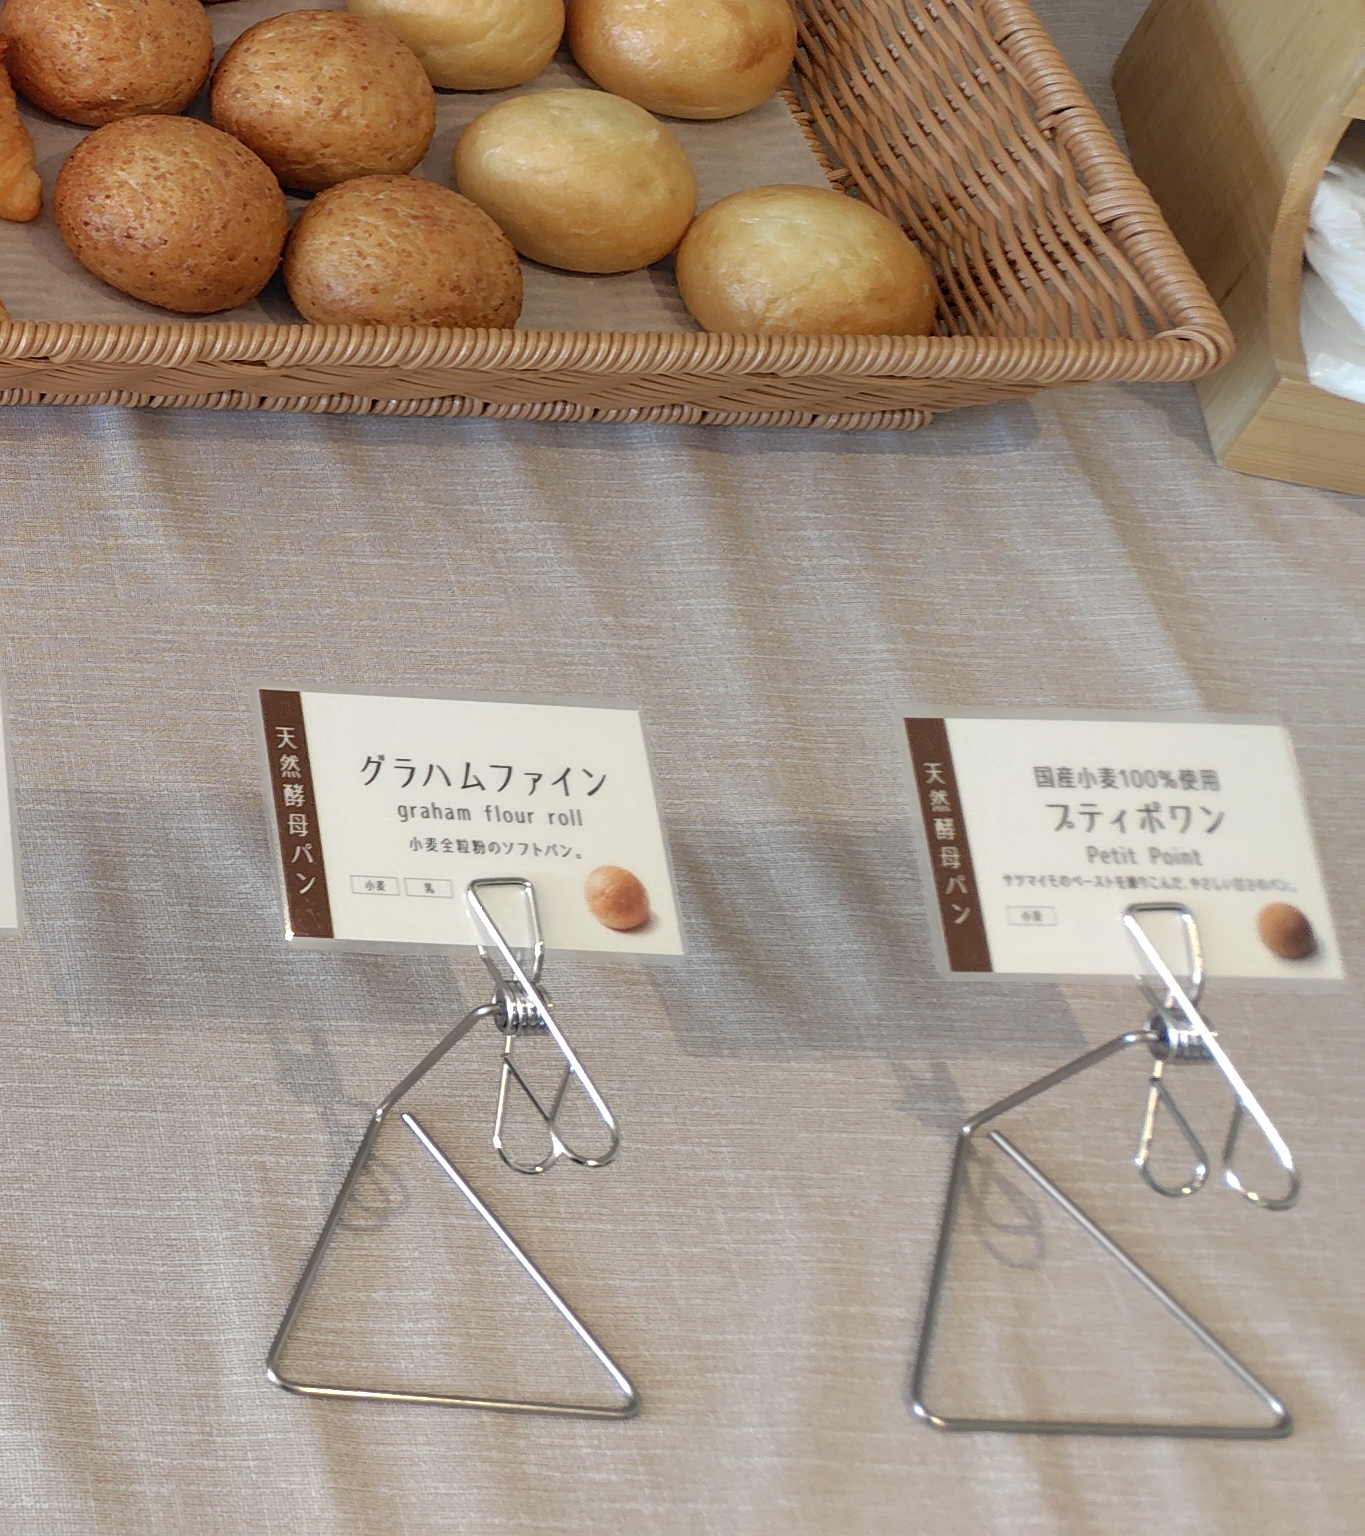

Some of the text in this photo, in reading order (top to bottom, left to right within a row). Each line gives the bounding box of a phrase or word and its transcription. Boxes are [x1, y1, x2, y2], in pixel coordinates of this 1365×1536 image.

[361, 755, 606, 796] グラハムファイン
[1034, 766, 1219, 791] 国産小麦100%使用
[275, 727, 317, 894] 天然酵母パン
[398, 802, 583, 826] graham flour roll
[410, 837, 581, 859] 小麦全粒粉のソフトパン。
[923, 762, 971, 925] 天然酵母パン
[1086, 846, 1202, 866] Petit Point
[365, 881, 385, 891] 小麦
